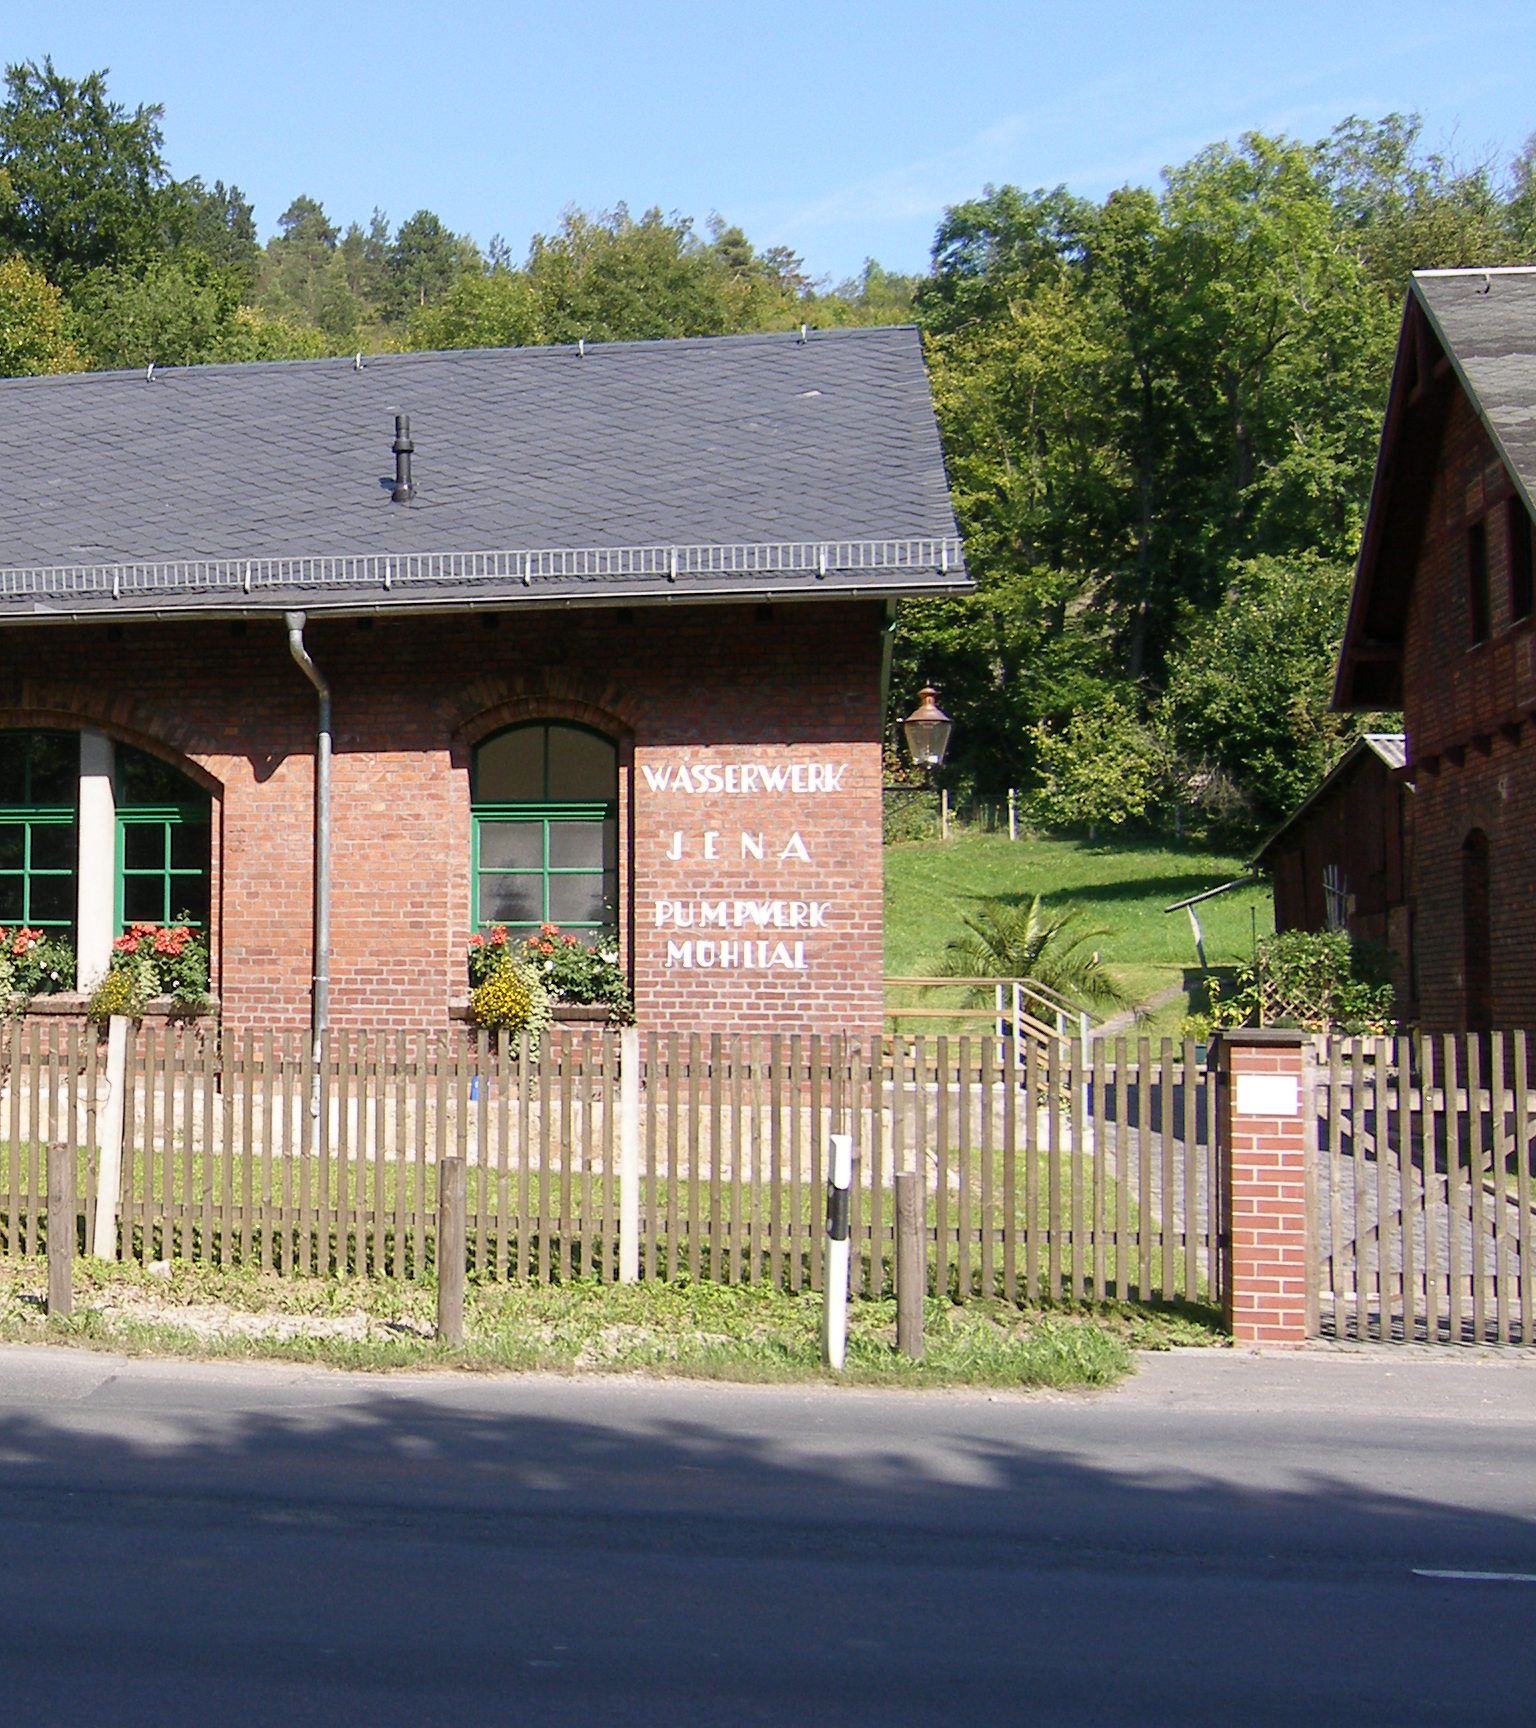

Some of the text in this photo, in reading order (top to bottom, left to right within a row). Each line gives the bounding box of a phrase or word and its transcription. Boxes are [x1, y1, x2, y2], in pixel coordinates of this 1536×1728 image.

[641, 763, 849, 793] WASSERWERK
[665, 831, 812, 862] JENA
[654, 900, 832, 928] PUMPWERK
